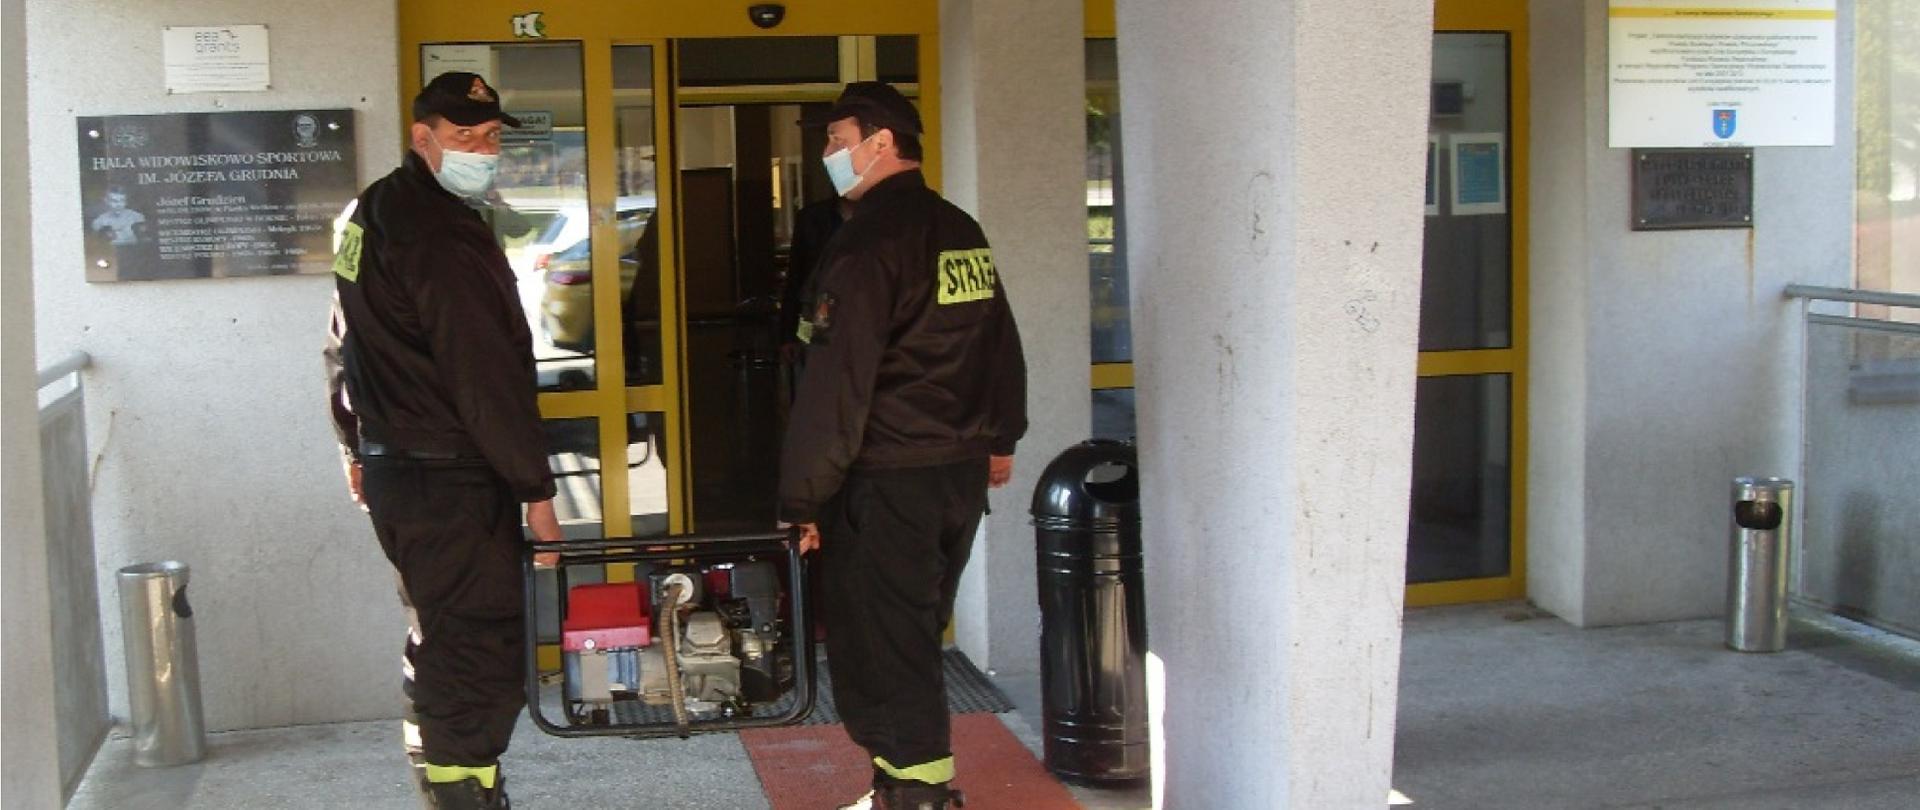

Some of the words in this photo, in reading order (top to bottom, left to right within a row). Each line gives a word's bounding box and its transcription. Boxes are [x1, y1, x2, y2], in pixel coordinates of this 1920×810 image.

[92, 156, 136, 171] HALA
[139, 153, 254, 168] WIDOWISKOWO
[258, 150, 343, 165] SPORTOWA
[138, 173, 160, 185] IM.
[163, 169, 226, 184] JÓZEFA
[229, 169, 298, 182] GRUDNIA
